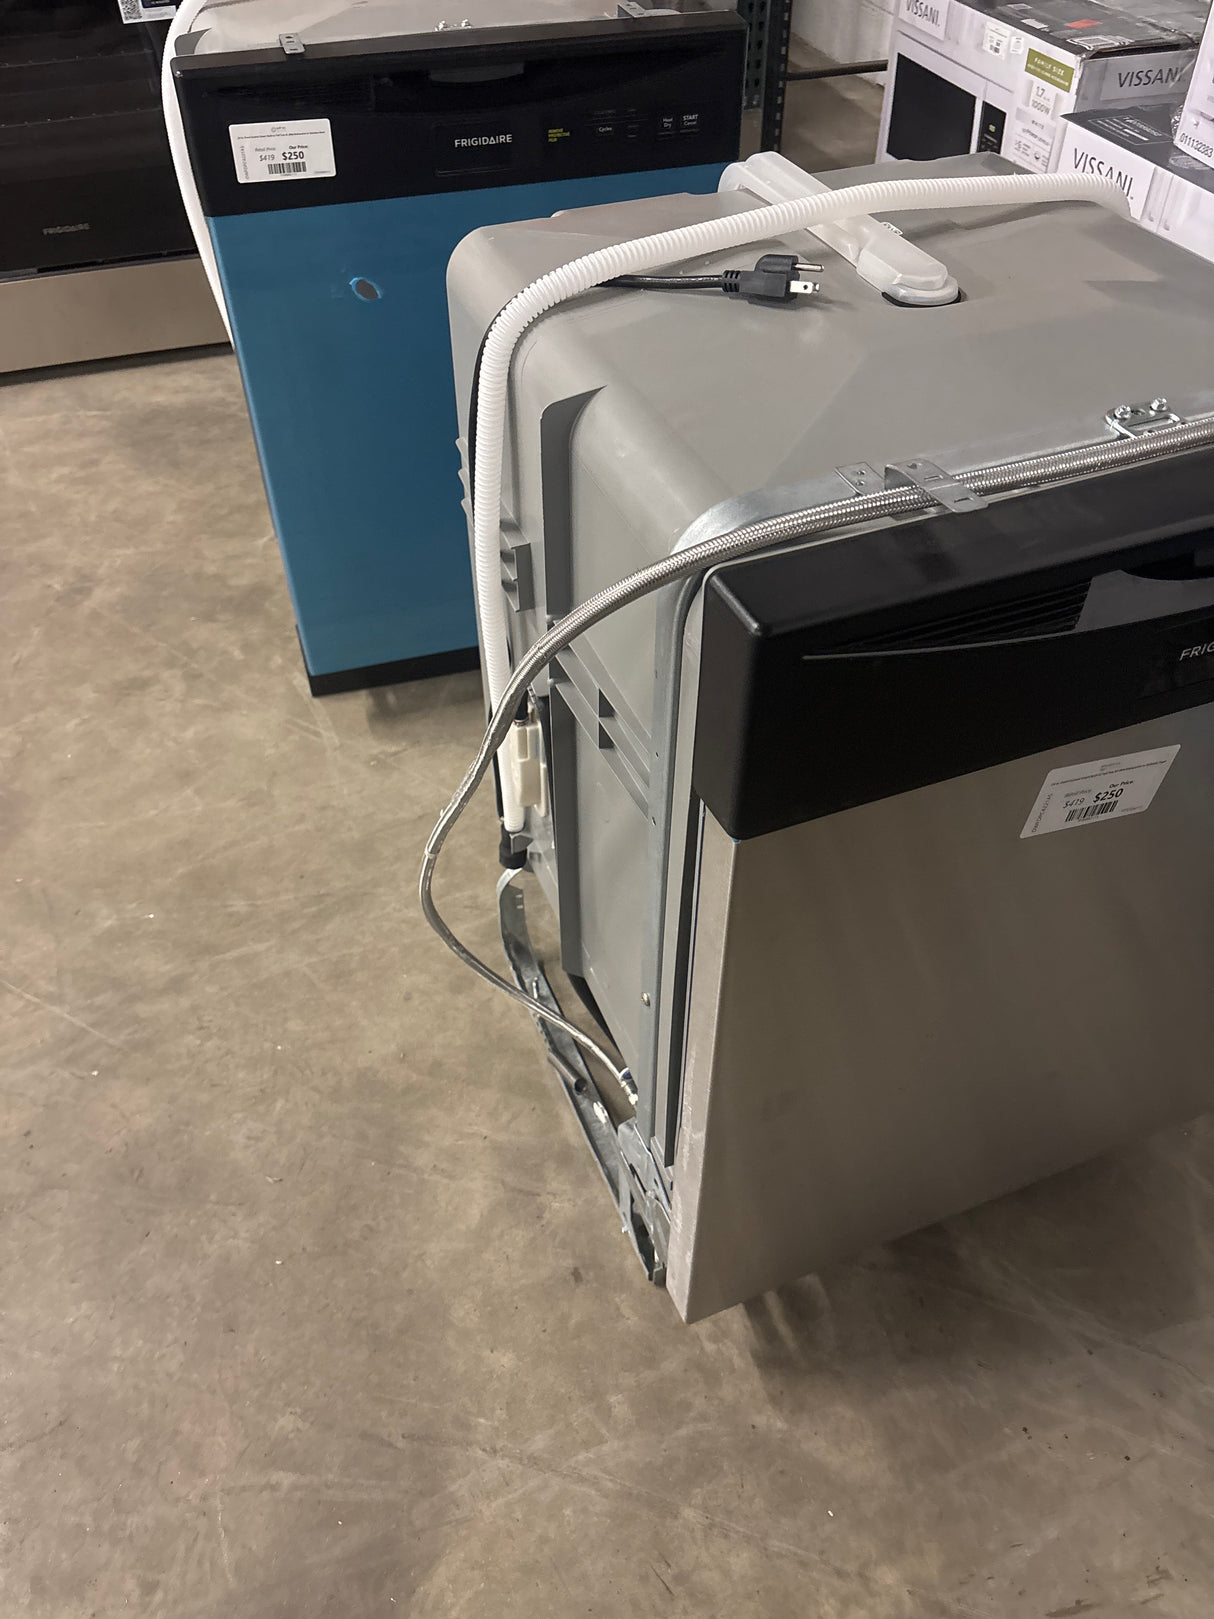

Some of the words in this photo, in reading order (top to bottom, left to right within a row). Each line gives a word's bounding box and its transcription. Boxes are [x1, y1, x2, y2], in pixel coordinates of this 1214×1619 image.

[454, 134, 513, 148] FRIGIDAIRE
[281, 151, 305, 161] $250
[1093, 788, 1125, 803] $250
